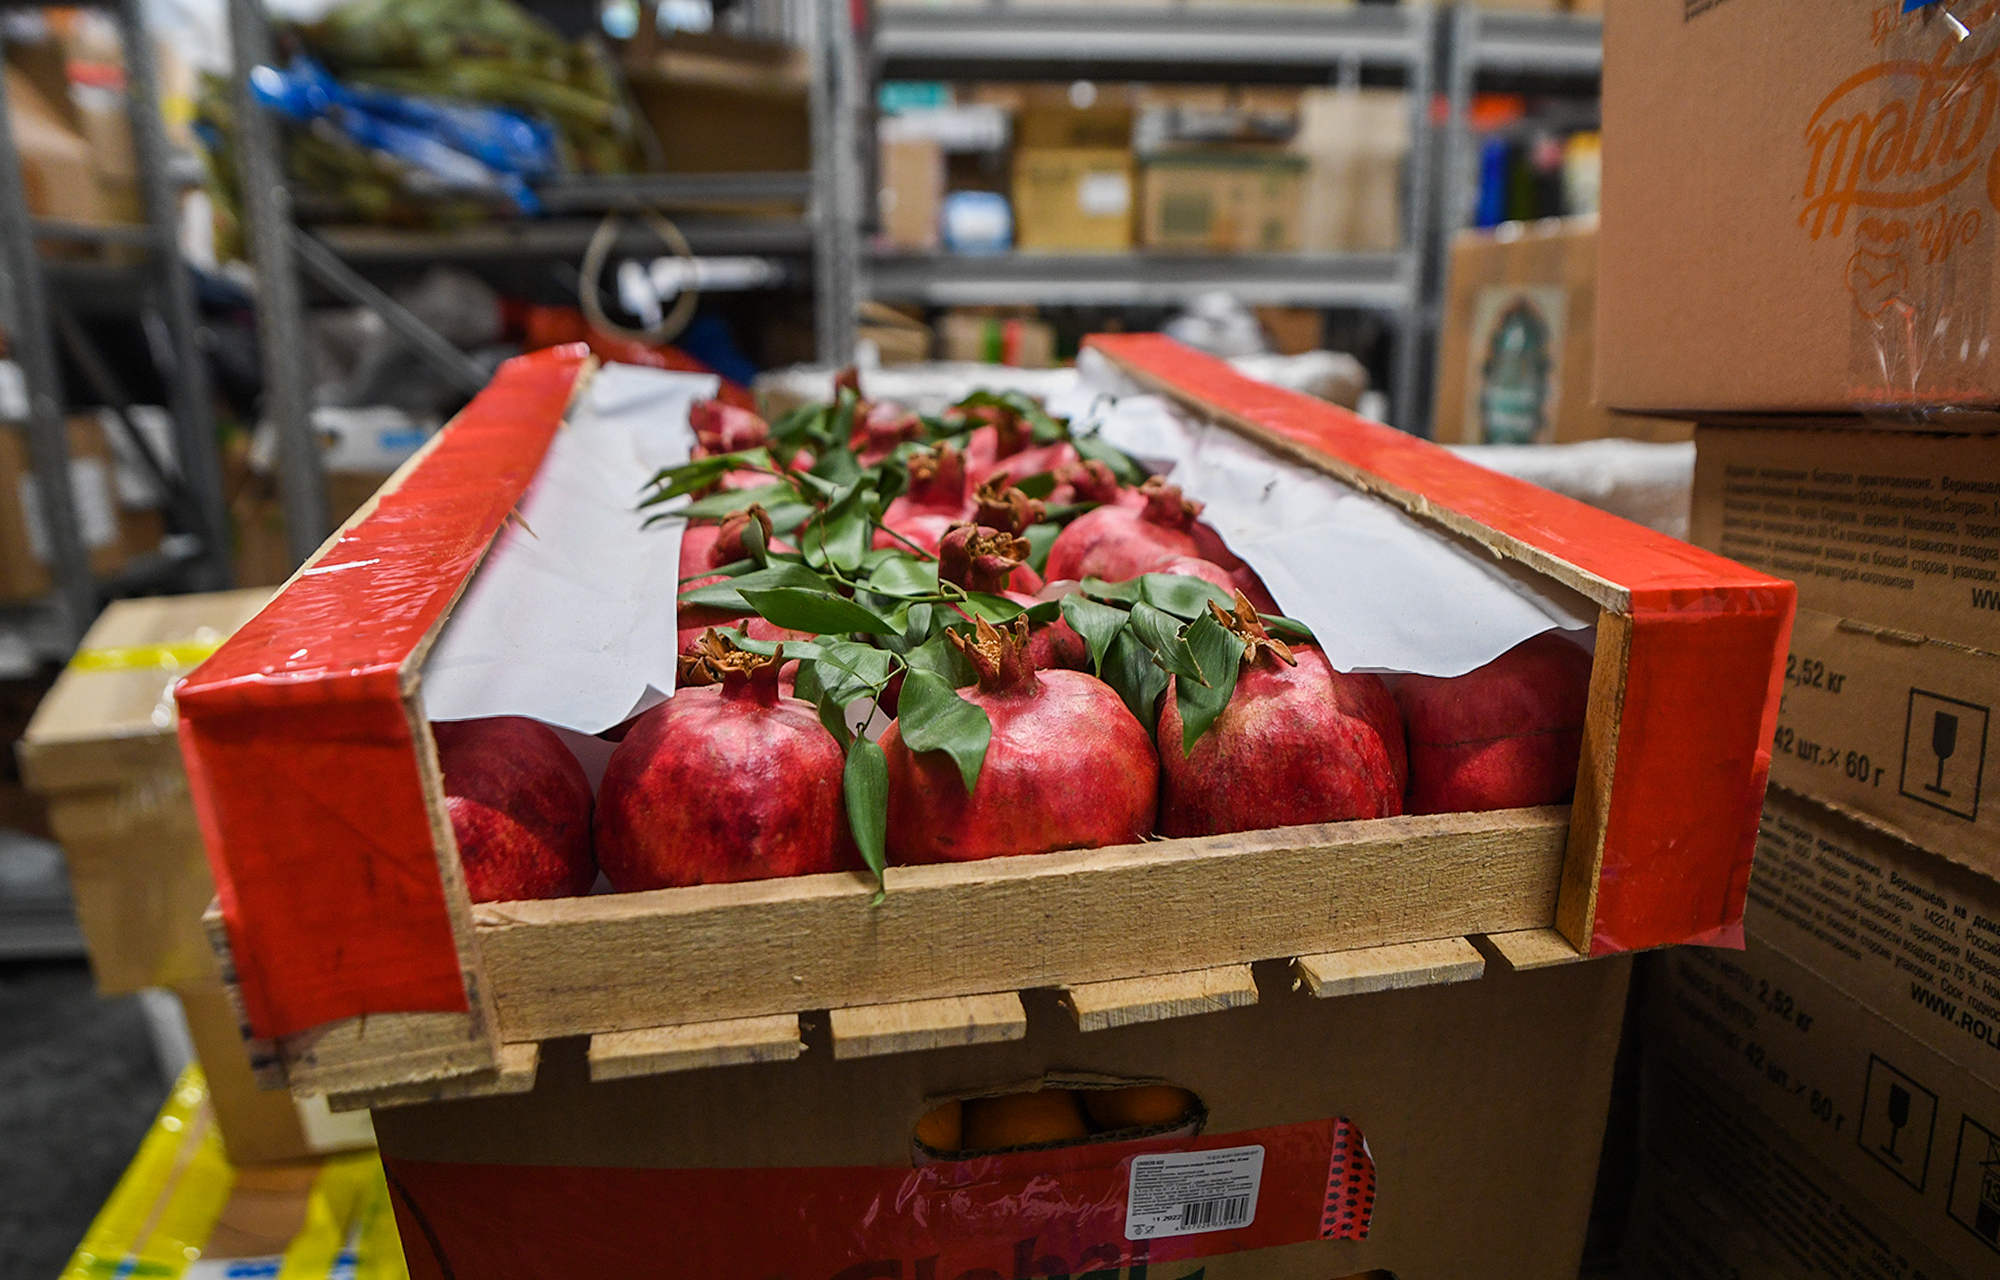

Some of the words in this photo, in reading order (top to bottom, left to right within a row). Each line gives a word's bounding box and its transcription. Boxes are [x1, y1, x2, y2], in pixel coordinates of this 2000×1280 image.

[1922, 495, 1942, 513] Фуд
[1903, 514, 1959, 537] Ивановское,
[1872, 550, 1908, 567] боковой
[1911, 558, 1949, 576] стороне
[1952, 564, 1999, 583] упаковки.
[1909, 538, 1958, 556] влажности
[1959, 544, 2000, 563] воздуха
[1785, 653, 1825, 688] 2,52
[1828, 671, 1847, 694] кг
[1845, 750, 1871, 783] 60
[1873, 767, 1886, 788] г
[1890, 870, 1948, 911] Вермишель
[1953, 904, 1967, 920] на
[1909, 920, 1960, 958] территория
[1924, 906, 1959, 938] 142214,
[1902, 936, 1937, 966] воздуха
[1937, 956, 1952, 974] до
[1953, 962, 1966, 982] 75
[1758, 979, 1796, 1022] 2,52
[1796, 1010, 1815, 1033] кг
[1940, 976, 1965, 1001] Срок
[1910, 981, 2000, 1052] WWW.ROL
[1745, 1041, 1766, 1070] 42
[1809, 1088, 1834, 1122] 60
[1835, 1112, 1846, 1132] г
